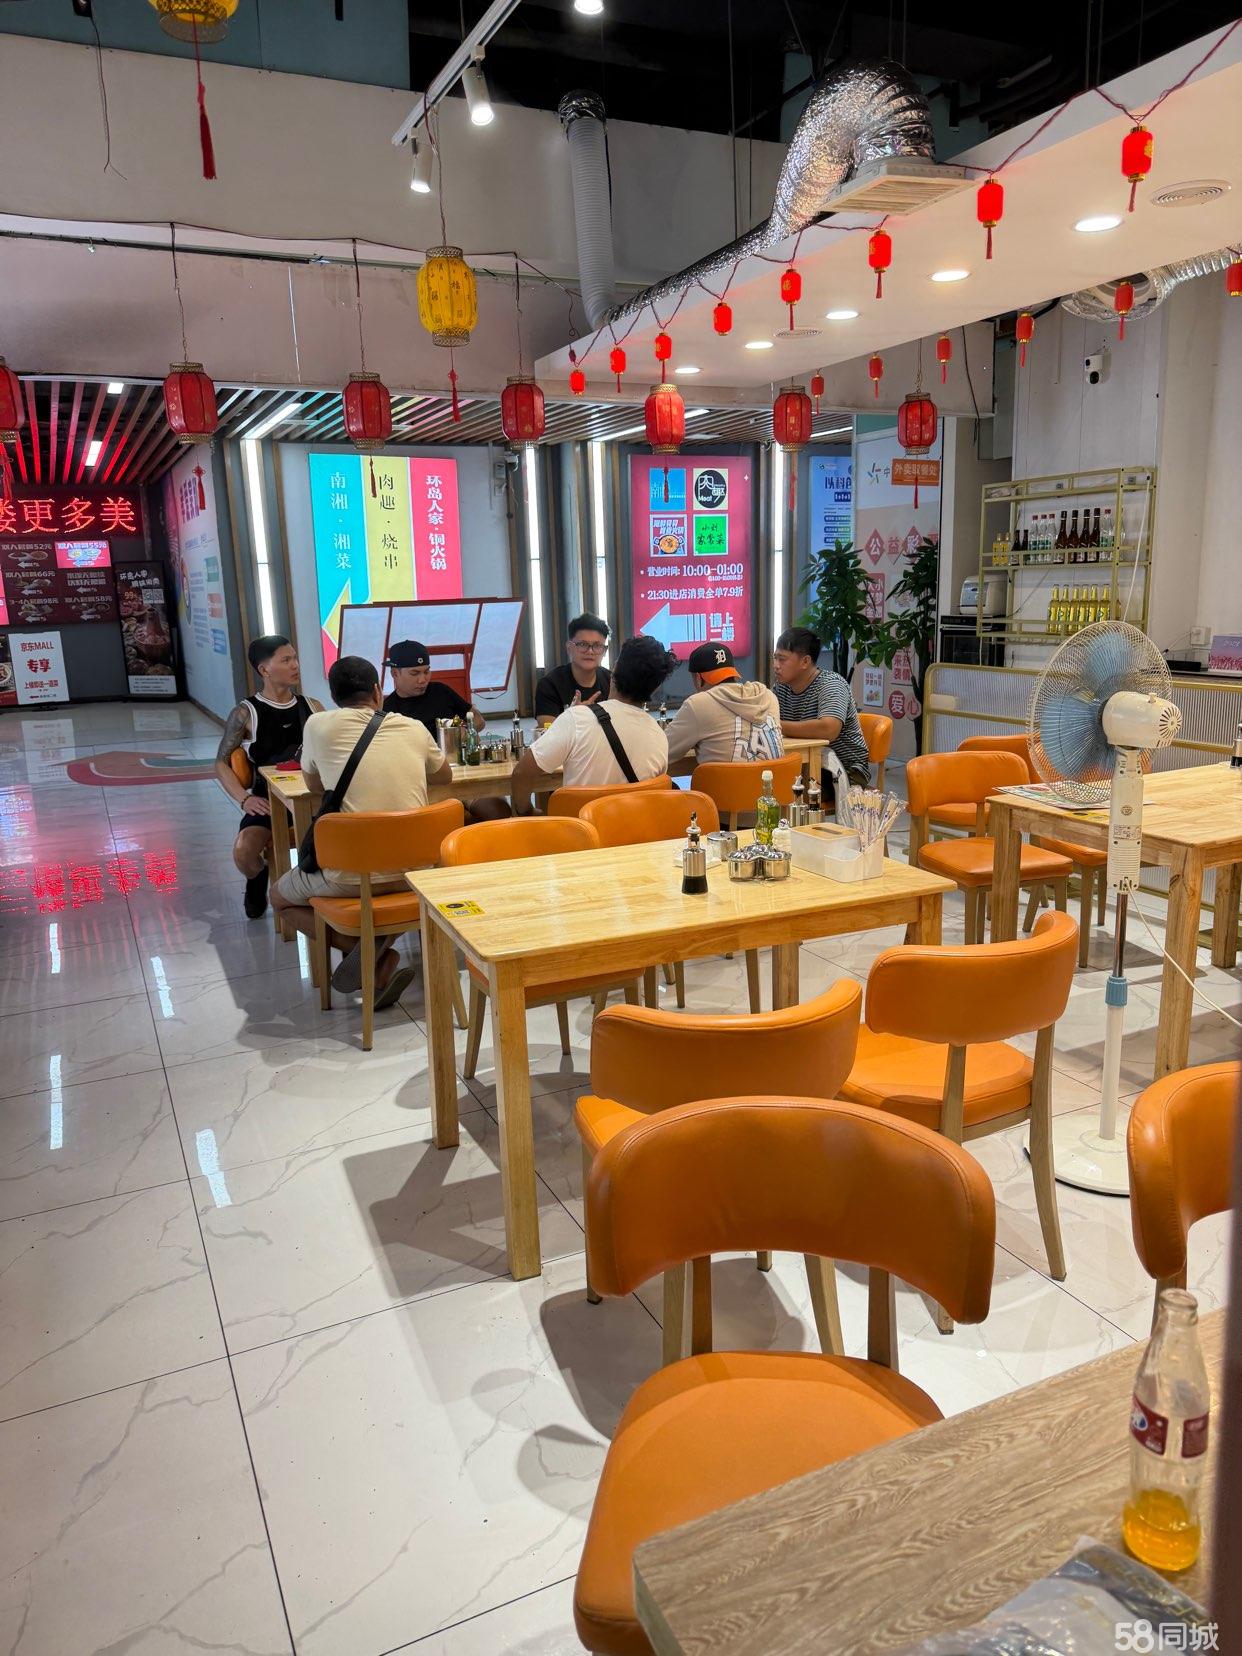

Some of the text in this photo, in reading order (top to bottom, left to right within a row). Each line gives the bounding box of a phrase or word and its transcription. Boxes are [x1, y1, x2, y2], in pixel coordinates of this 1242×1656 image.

[895, 463, 937, 476] 外卖取餐处
[20, 641, 54, 652] 京东MALL
[27, 658, 51, 673] 专享
